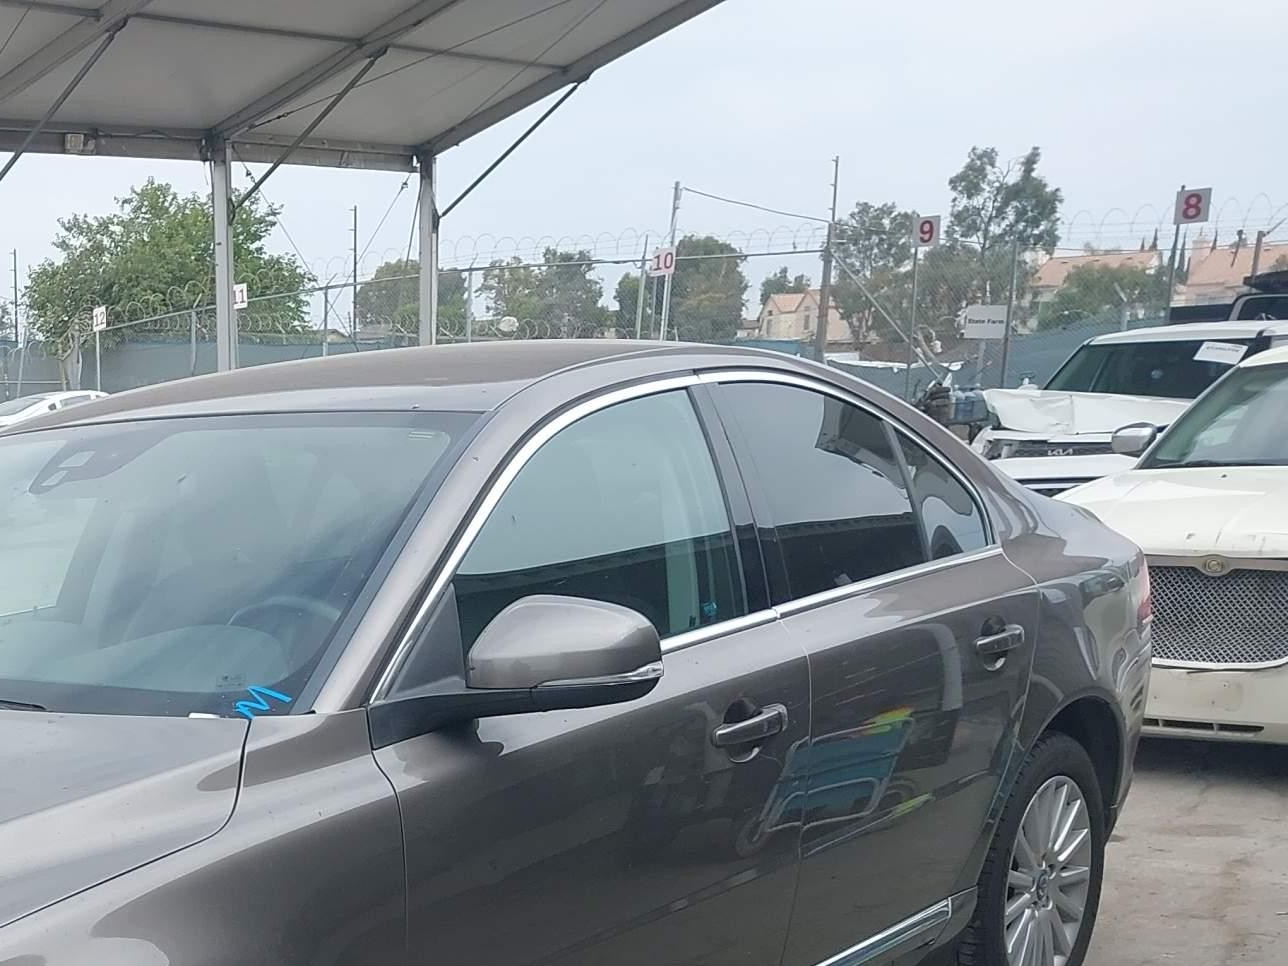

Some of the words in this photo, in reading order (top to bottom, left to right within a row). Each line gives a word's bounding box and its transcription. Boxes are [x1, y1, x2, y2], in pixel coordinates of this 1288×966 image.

[1183, 193, 1202, 220] 8
[919, 220, 934, 243] 9
[653, 252, 674, 271] 10
[94, 311, 106, 327] 12
